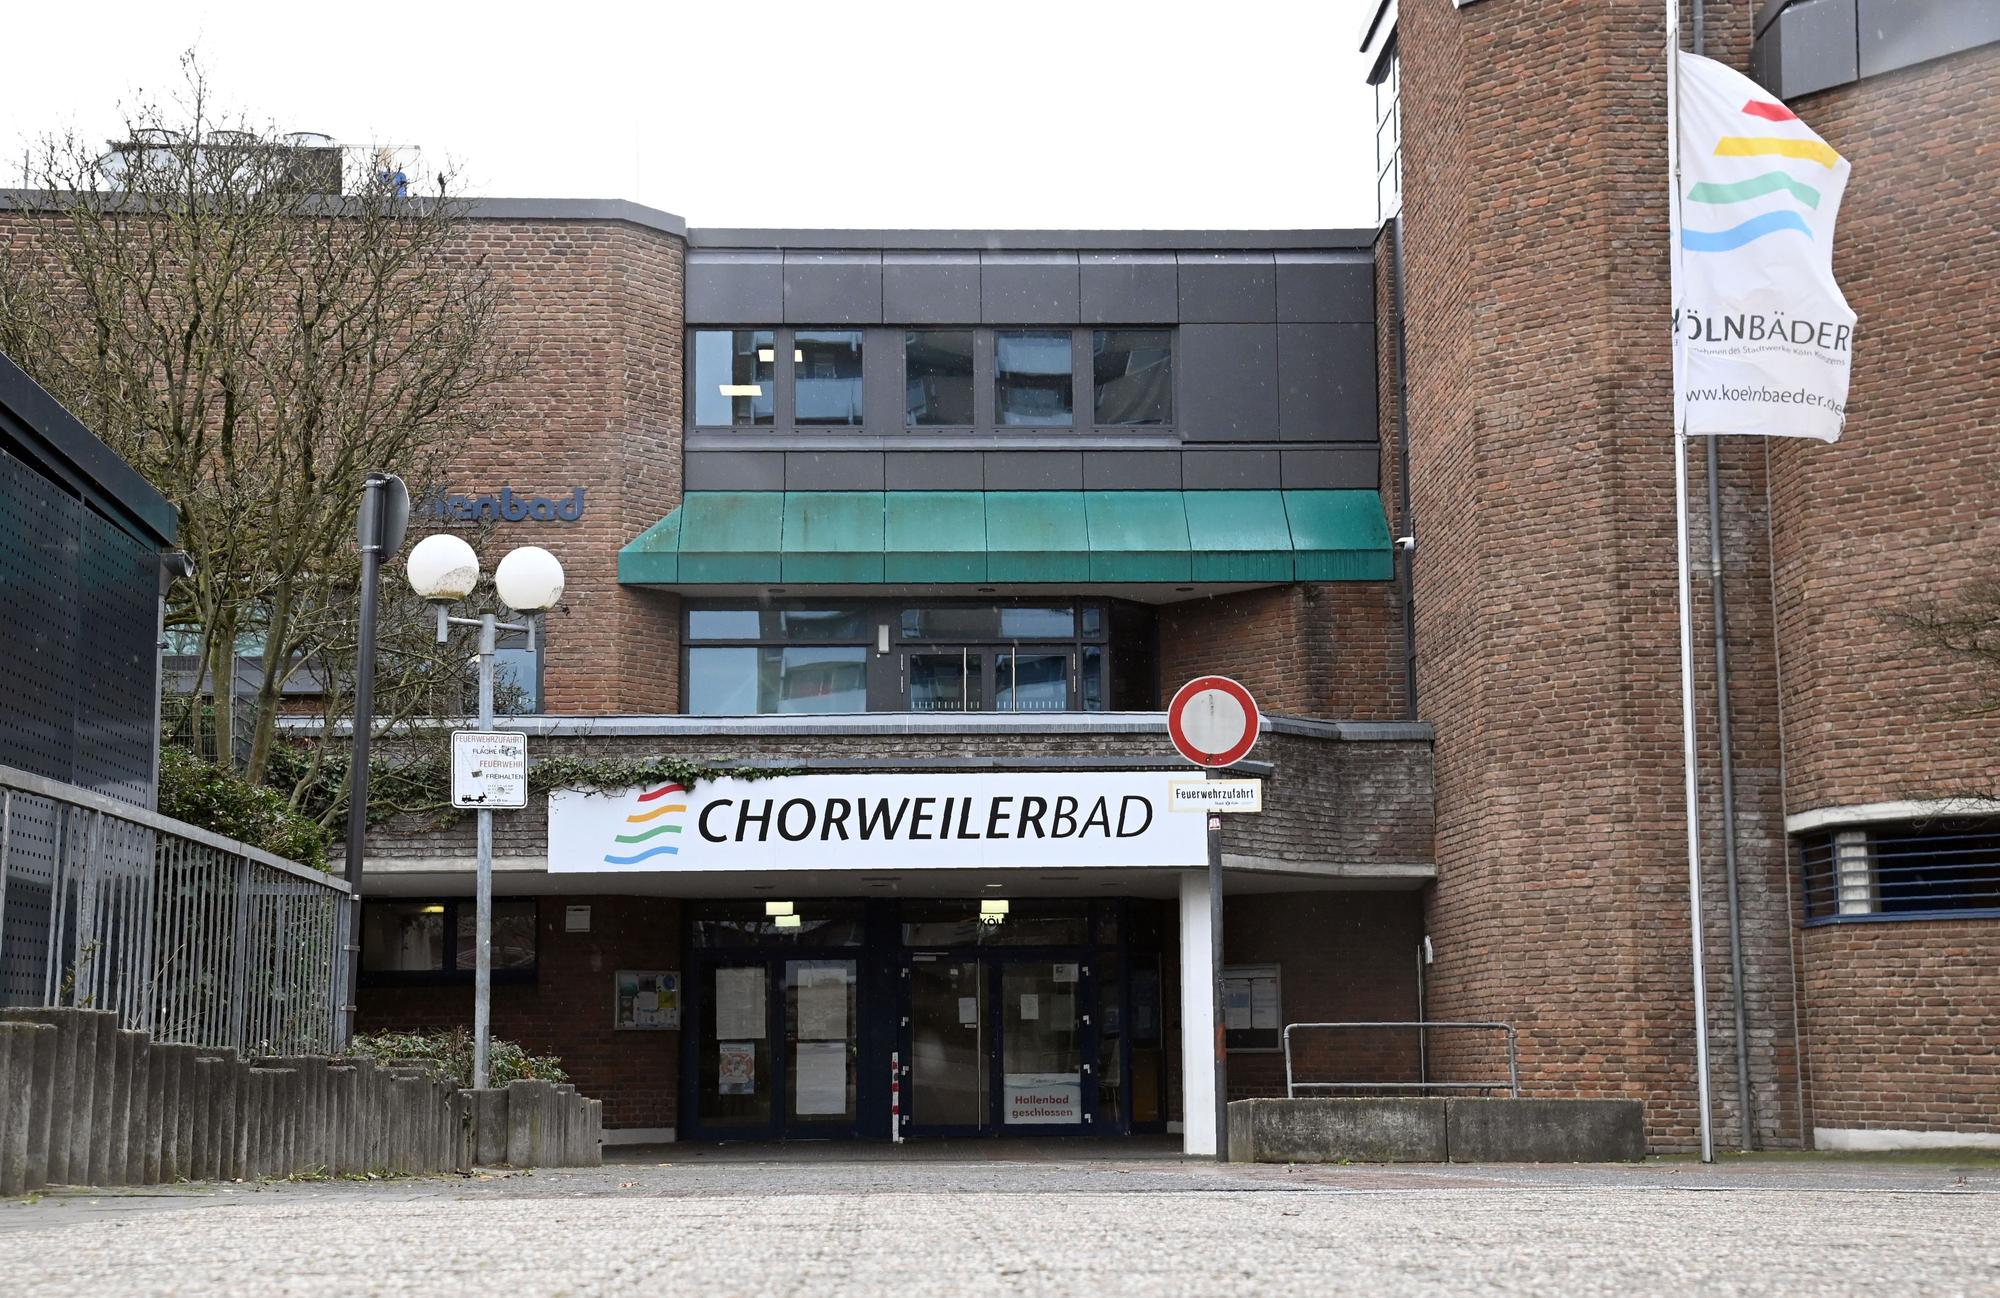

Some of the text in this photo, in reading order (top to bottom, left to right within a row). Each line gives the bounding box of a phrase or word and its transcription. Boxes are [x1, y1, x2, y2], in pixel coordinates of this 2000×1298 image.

[1686, 384, 1842, 416] ww.koelnbaeder.de
[456, 735, 523, 744] FEUERWEHRZUFAHRT
[480, 760, 523, 768] FEUERWEHR
[1176, 788, 1254, 800] Feuerwehrzufahrt
[699, 795, 1153, 843] CHORWEILERBAD
[1015, 1094, 1069, 1104] Hallenbad
[1012, 1107, 1073, 1119] geschlossen
